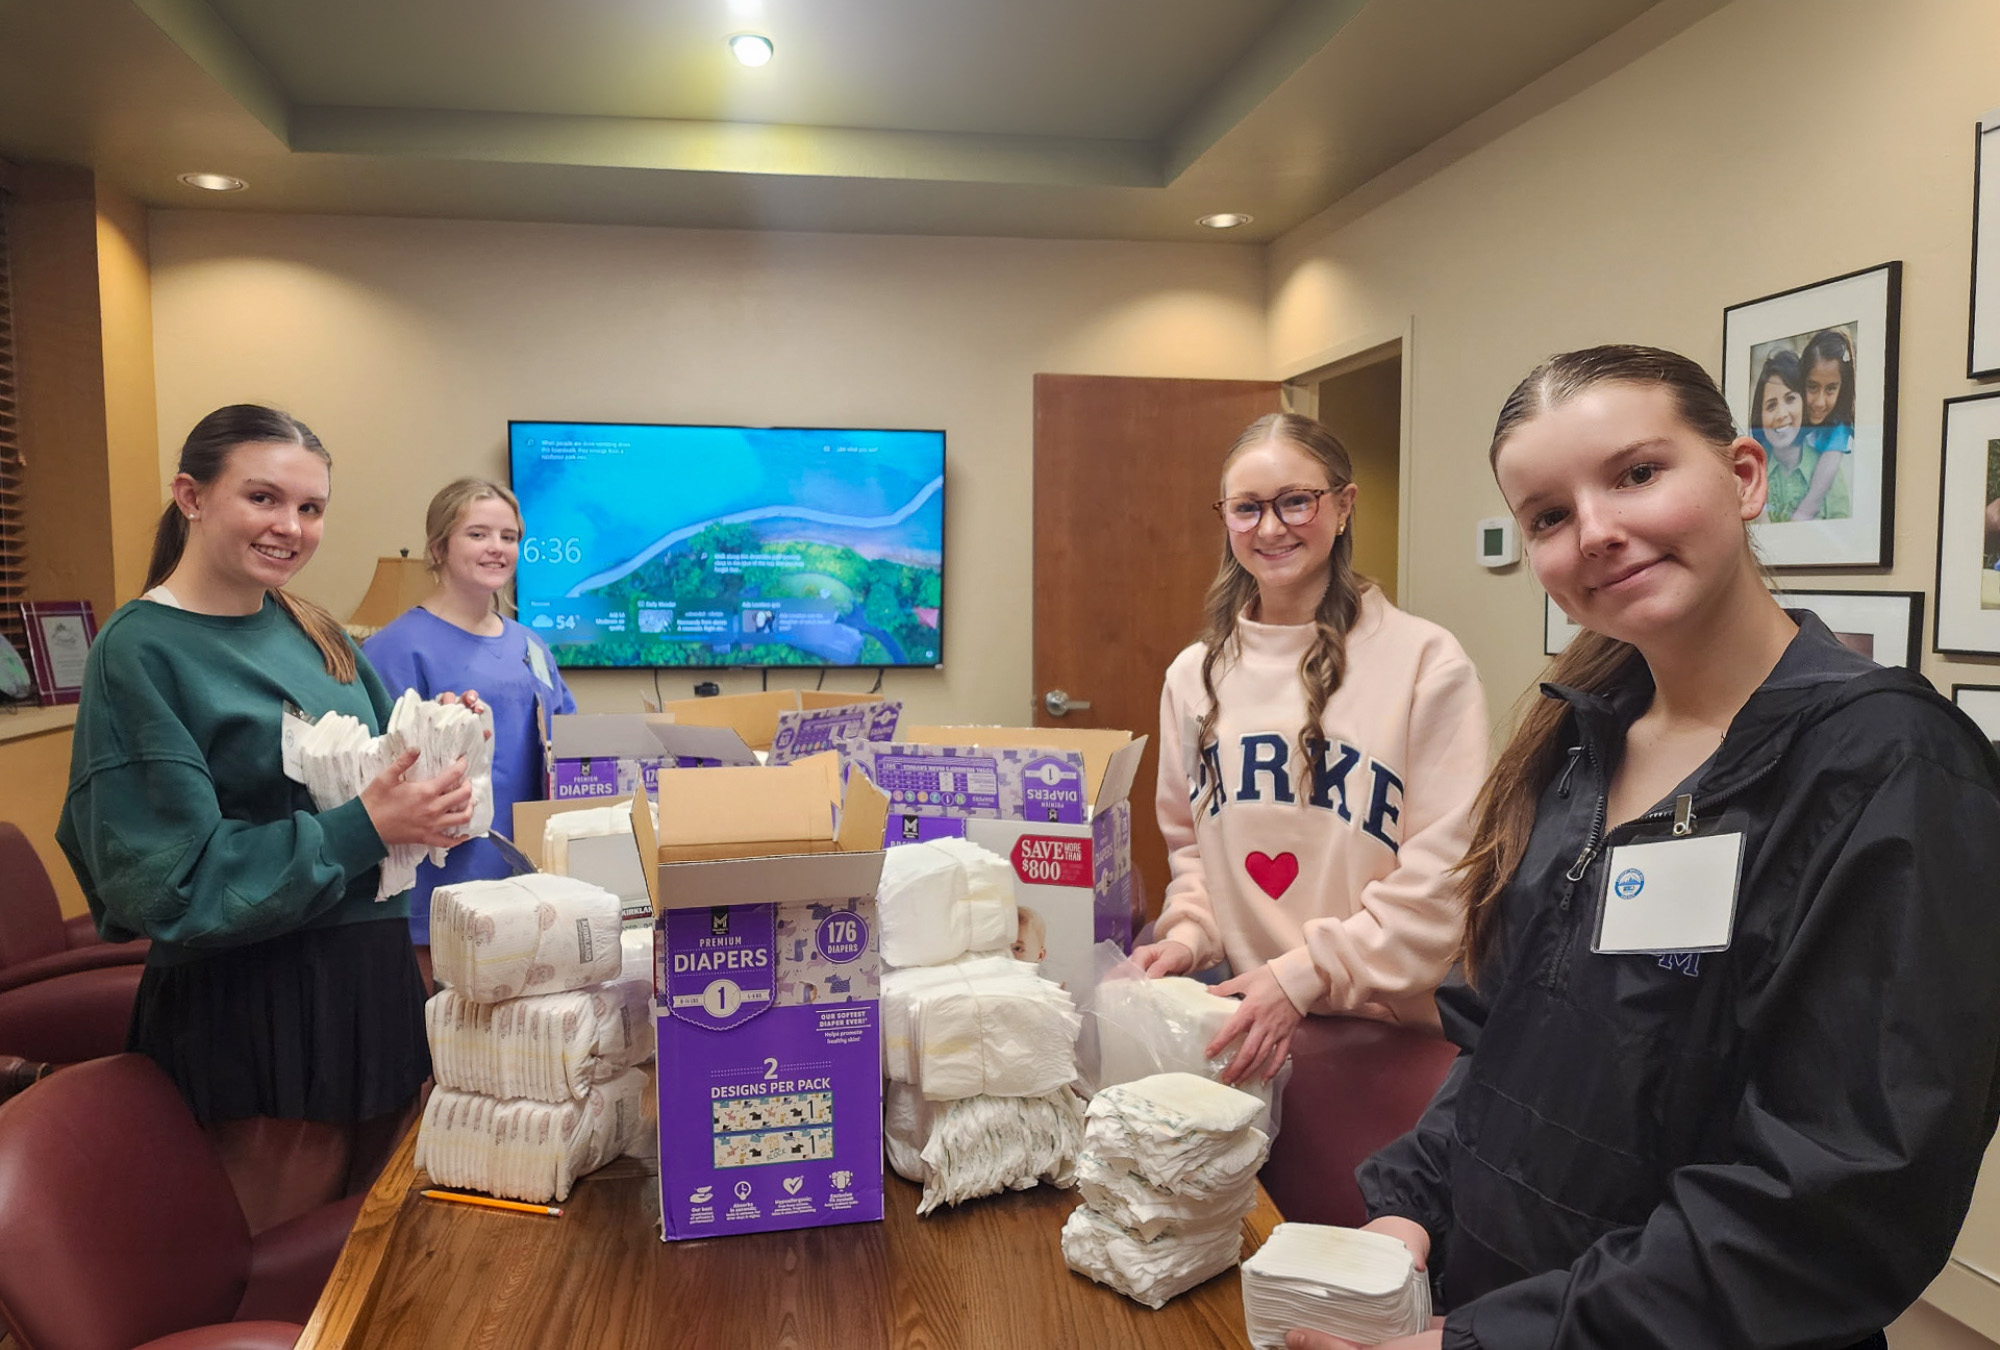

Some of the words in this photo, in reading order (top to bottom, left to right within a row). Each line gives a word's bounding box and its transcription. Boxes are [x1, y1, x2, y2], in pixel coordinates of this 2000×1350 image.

[524, 537, 582, 564] 6:36
[559, 783, 613, 796] DIAPERS
[1026, 789, 1077, 801] DIAPERS
[1190, 732, 1404, 858] ARKE
[1021, 839, 1064, 860] SAVE
[1064, 842, 1081, 852] MORE
[1065, 851, 1082, 861] THAN
[1022, 858, 1061, 880] $800
[699, 936, 742, 948] PREMIUM
[827, 920, 857, 943] 176
[827, 943, 858, 954] DIAPERS
[674, 948, 768, 973] DIAPERS
[717, 986, 726, 1010] 1
[819, 1019, 845, 1027] DIAPER
[837, 1011, 867, 1019] SOFTEST
[763, 1057, 779, 1080] 2
[711, 1083, 767, 1099] DESIGNS
[770, 1081, 794, 1094] PER
[797, 1077, 831, 1091] PACK
